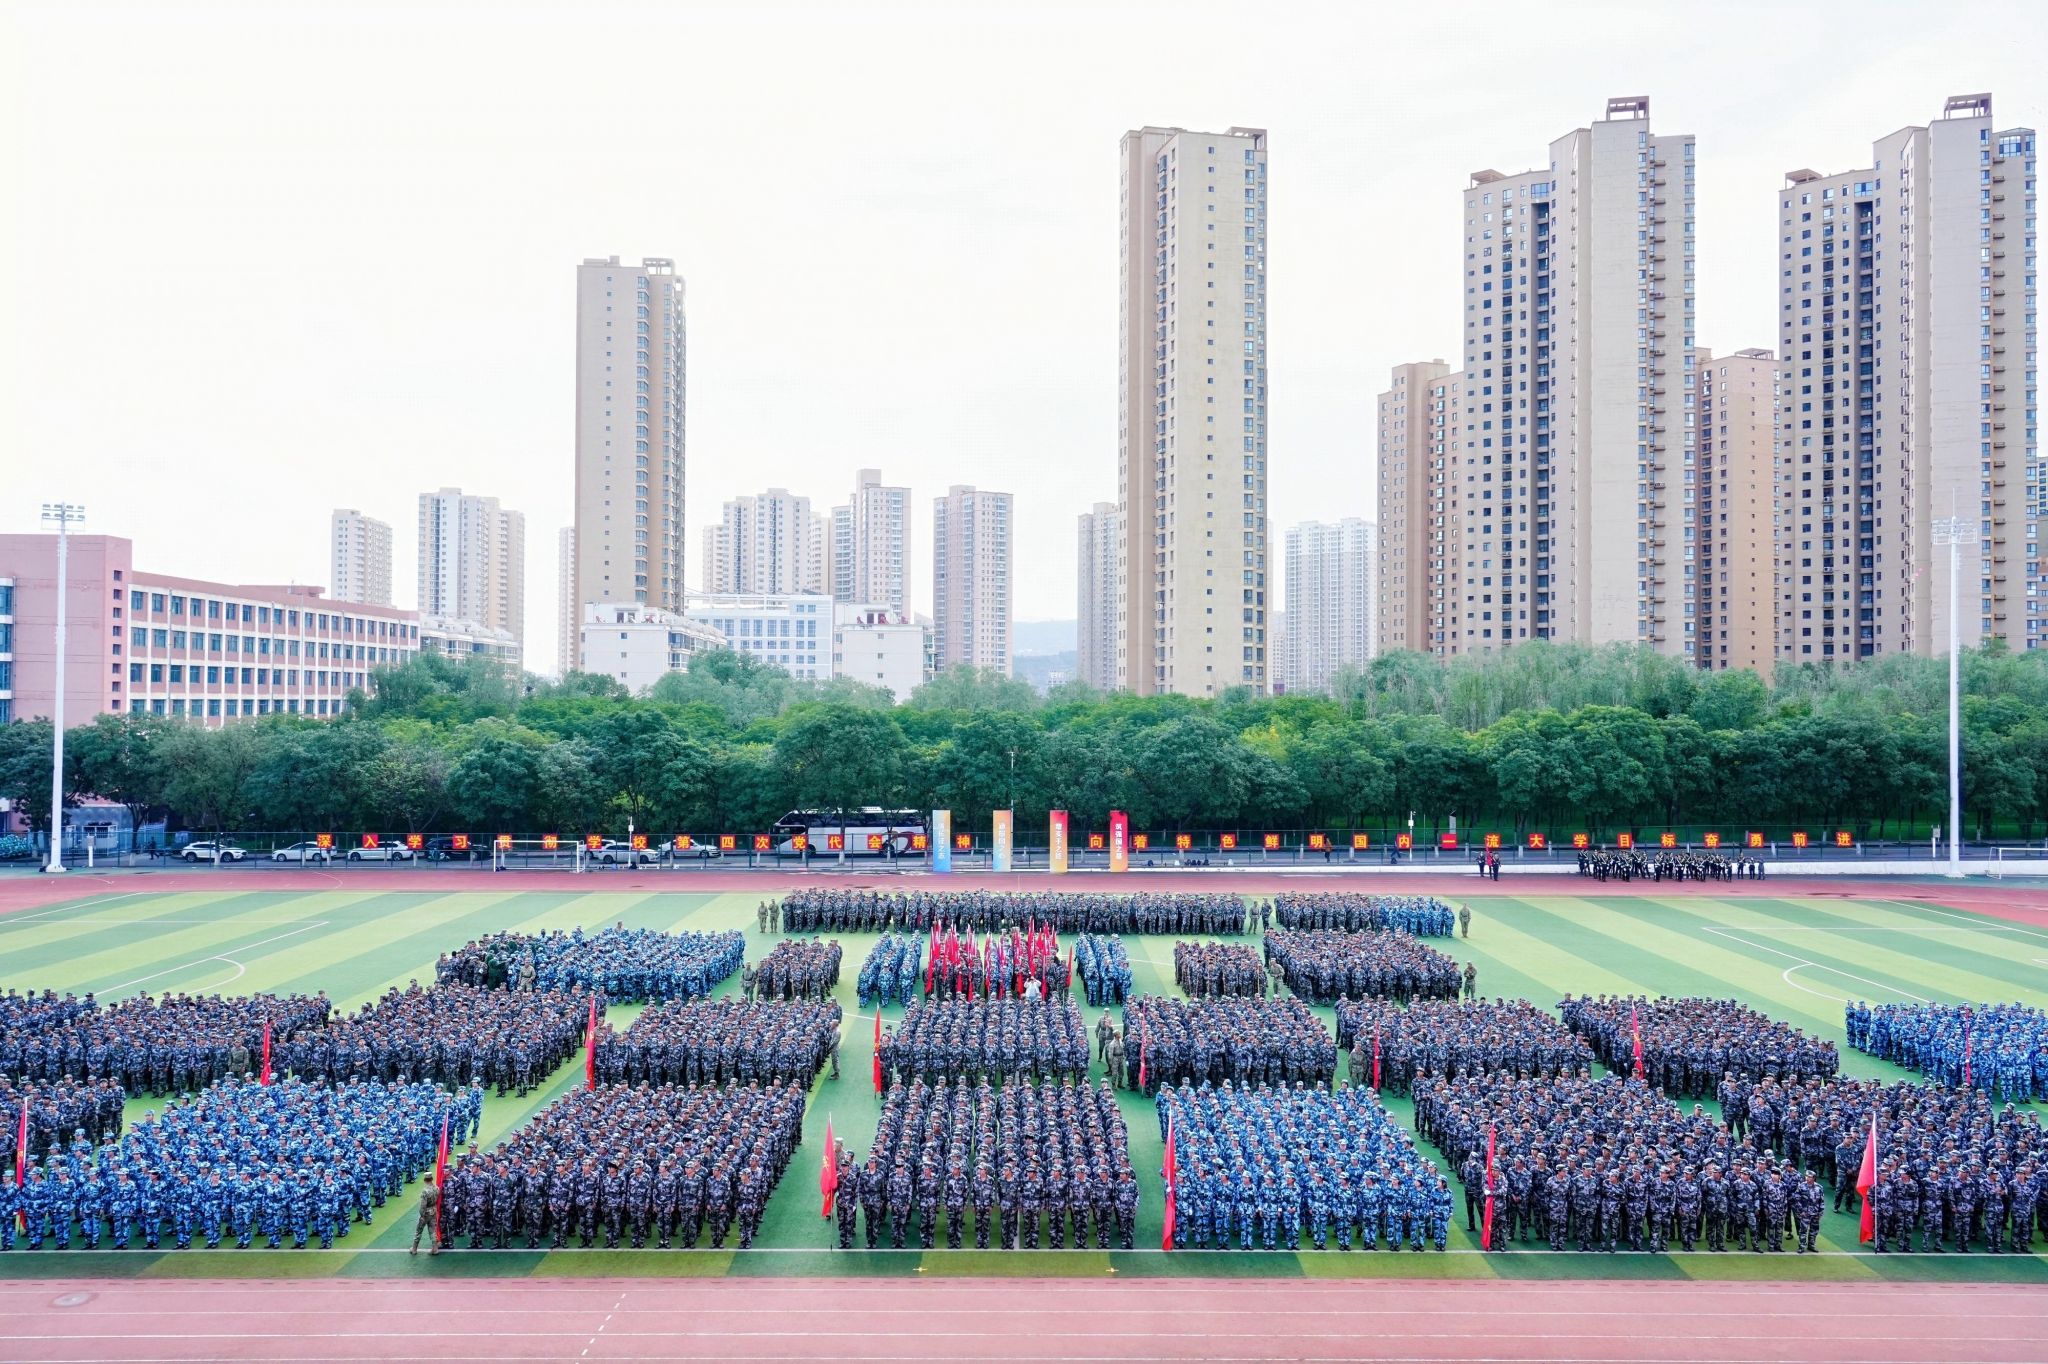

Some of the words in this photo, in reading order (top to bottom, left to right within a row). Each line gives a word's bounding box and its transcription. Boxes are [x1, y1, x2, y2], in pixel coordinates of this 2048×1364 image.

[318, 835, 330, 848] 深
[364, 835, 377, 848] 入
[409, 835, 421, 849] 学
[455, 836, 468, 849] 习
[499, 836, 511, 849] 贯
[544, 836, 556, 849] 彻
[588, 836, 600, 849] 学
[633, 836, 646, 849] 校
[677, 836, 691, 849] 第
[721, 837, 734, 849] 四
[756, 837, 768, 849] 次
[793, 836, 805, 849] 党
[829, 836, 841, 849] 代
[869, 836, 881, 849] 会
[913, 836, 925, 849] 精
[957, 835, 970, 849] 神
[1090, 835, 1103, 849] 向
[1134, 836, 1147, 849] 着
[1178, 836, 1190, 849] 特
[1222, 835, 1234, 849] 色
[1265, 835, 1278, 848] 鲜
[1310, 836, 1323, 849] 明
[1354, 836, 1367, 849] 国
[1398, 835, 1410, 849] 内
[1487, 835, 1499, 848] 流
[1530, 835, 1543, 848] 大
[1574, 835, 1586, 848] 学
[1619, 835, 1630, 847] 目
[1662, 834, 1674, 847] 标
[1706, 834, 1718, 847] 奋
[1750, 834, 1762, 847] 勇
[1793, 834, 1805, 847] 前
[1838, 833, 1850, 846] 进
